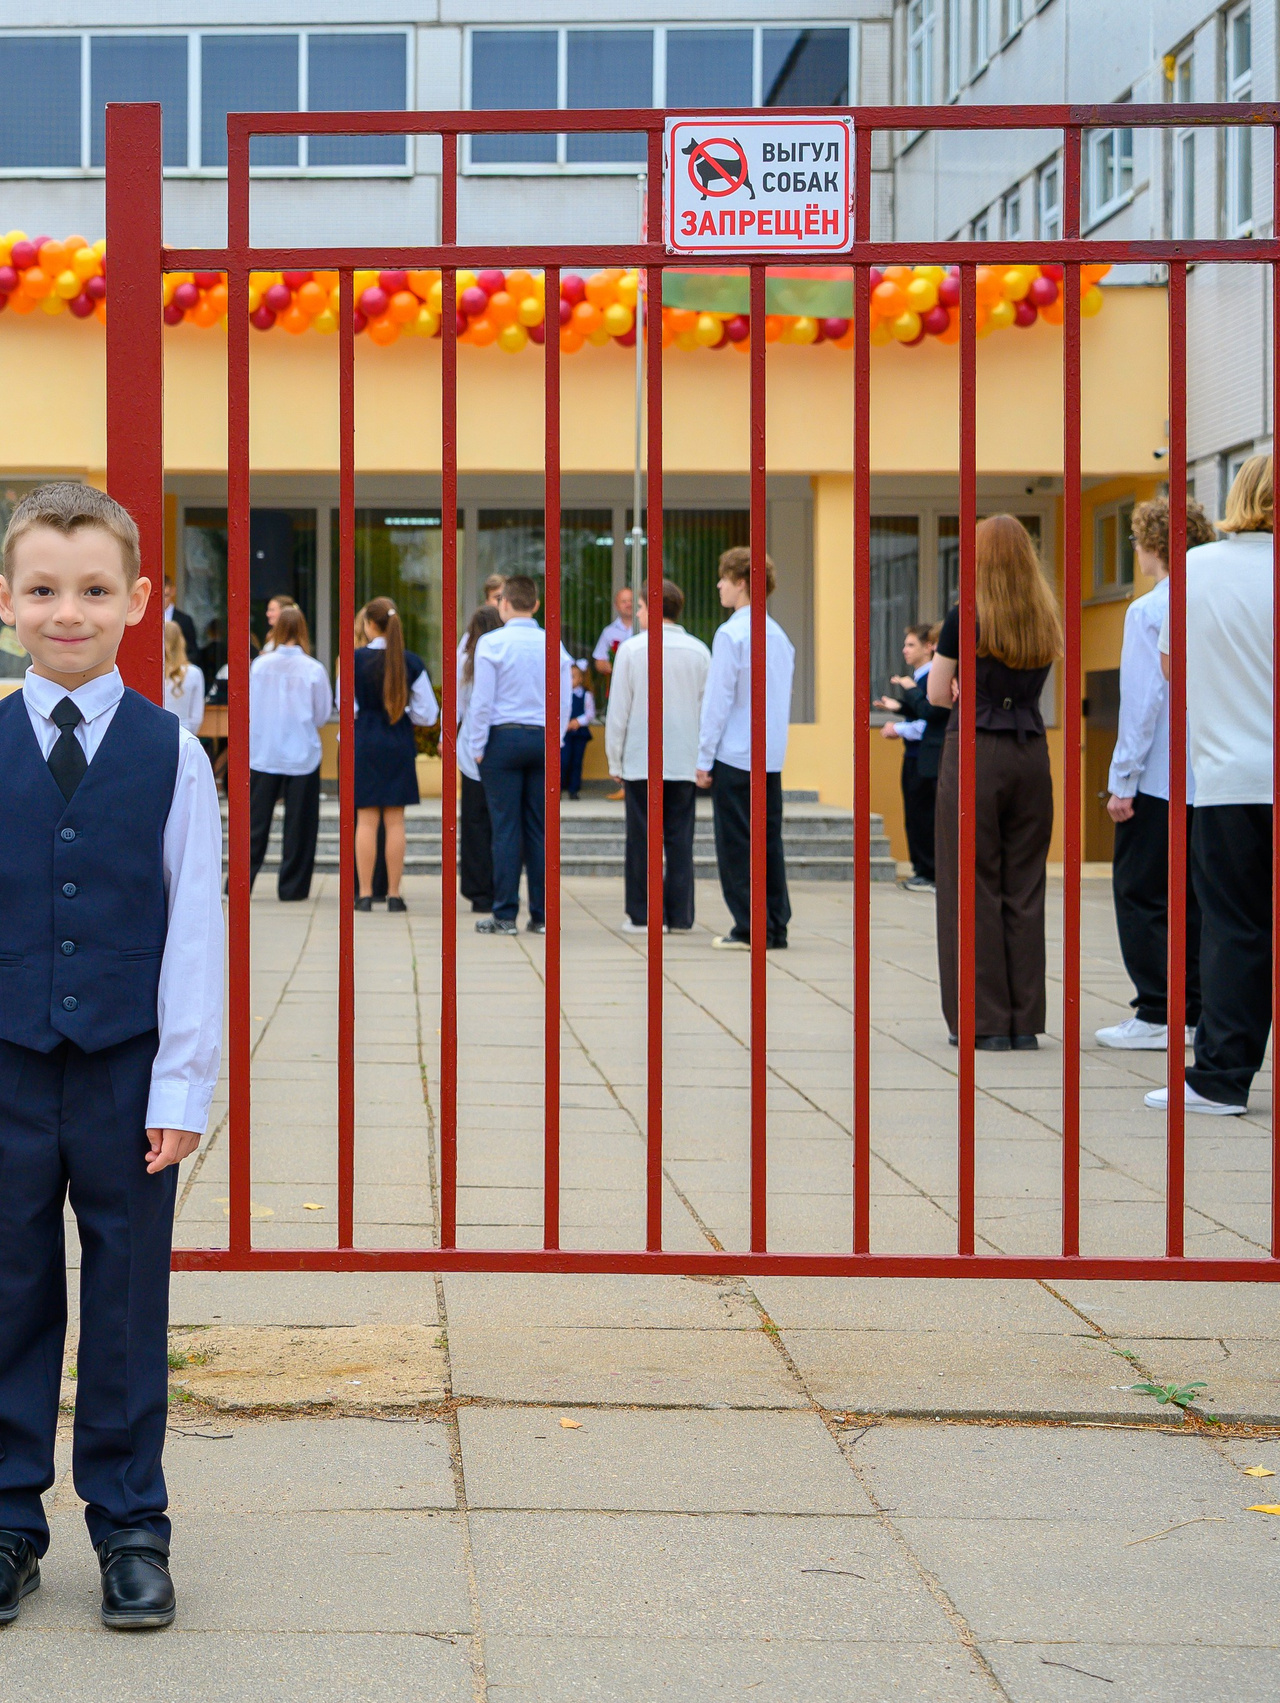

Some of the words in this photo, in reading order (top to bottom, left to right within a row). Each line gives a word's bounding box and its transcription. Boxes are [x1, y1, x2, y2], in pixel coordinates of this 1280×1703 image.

[762, 142, 839, 162] ВЫГУЛ
[762, 171, 839, 193] СОБАК
[680, 203, 839, 240] ЗАПРЕЩЁН
